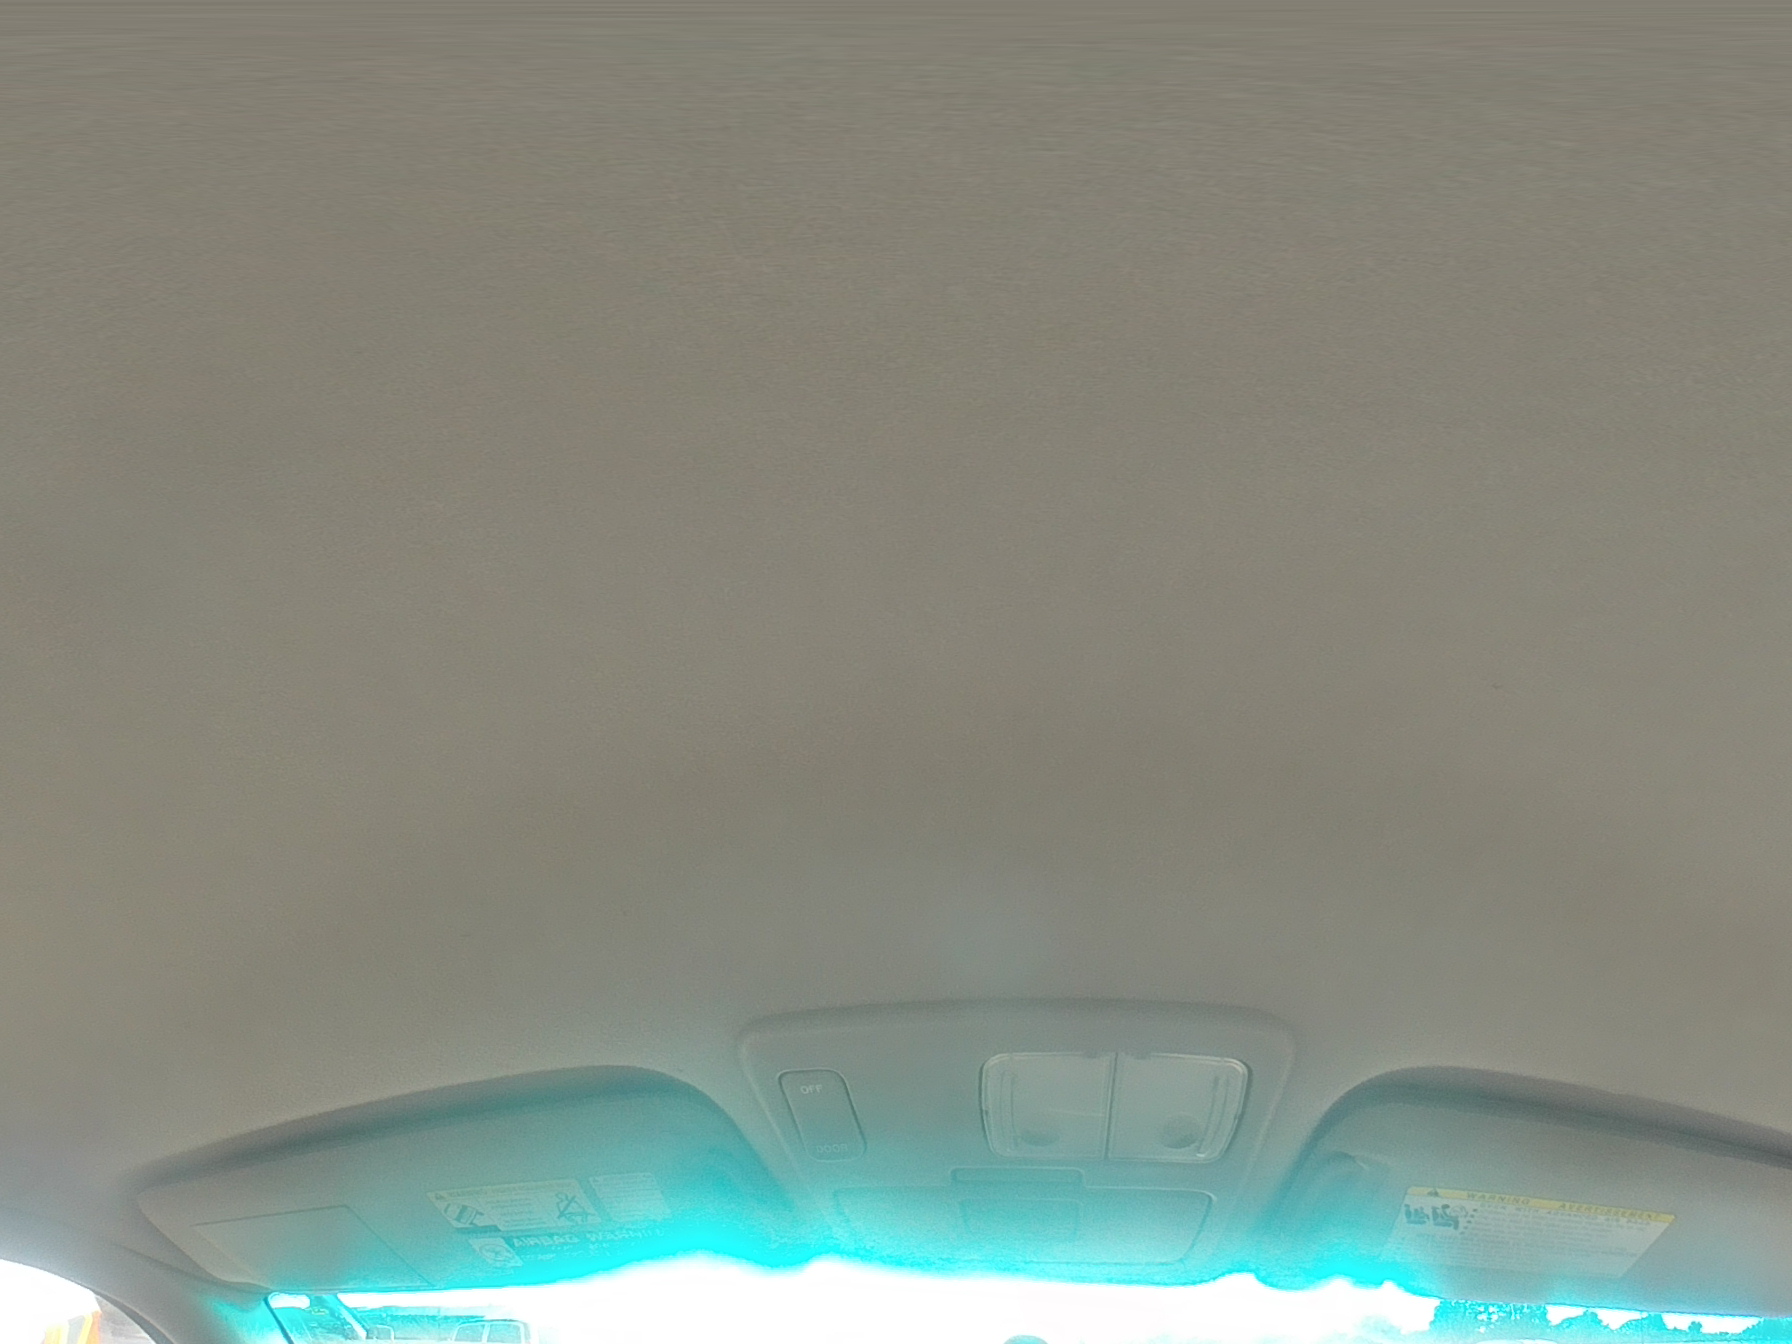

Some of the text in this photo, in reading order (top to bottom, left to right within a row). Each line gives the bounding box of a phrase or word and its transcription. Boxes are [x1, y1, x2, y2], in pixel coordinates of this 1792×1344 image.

[801, 1085, 822, 1094] OFF
[816, 1143, 848, 1153] DOOR
[1467, 1191, 1530, 1206] WARNING
